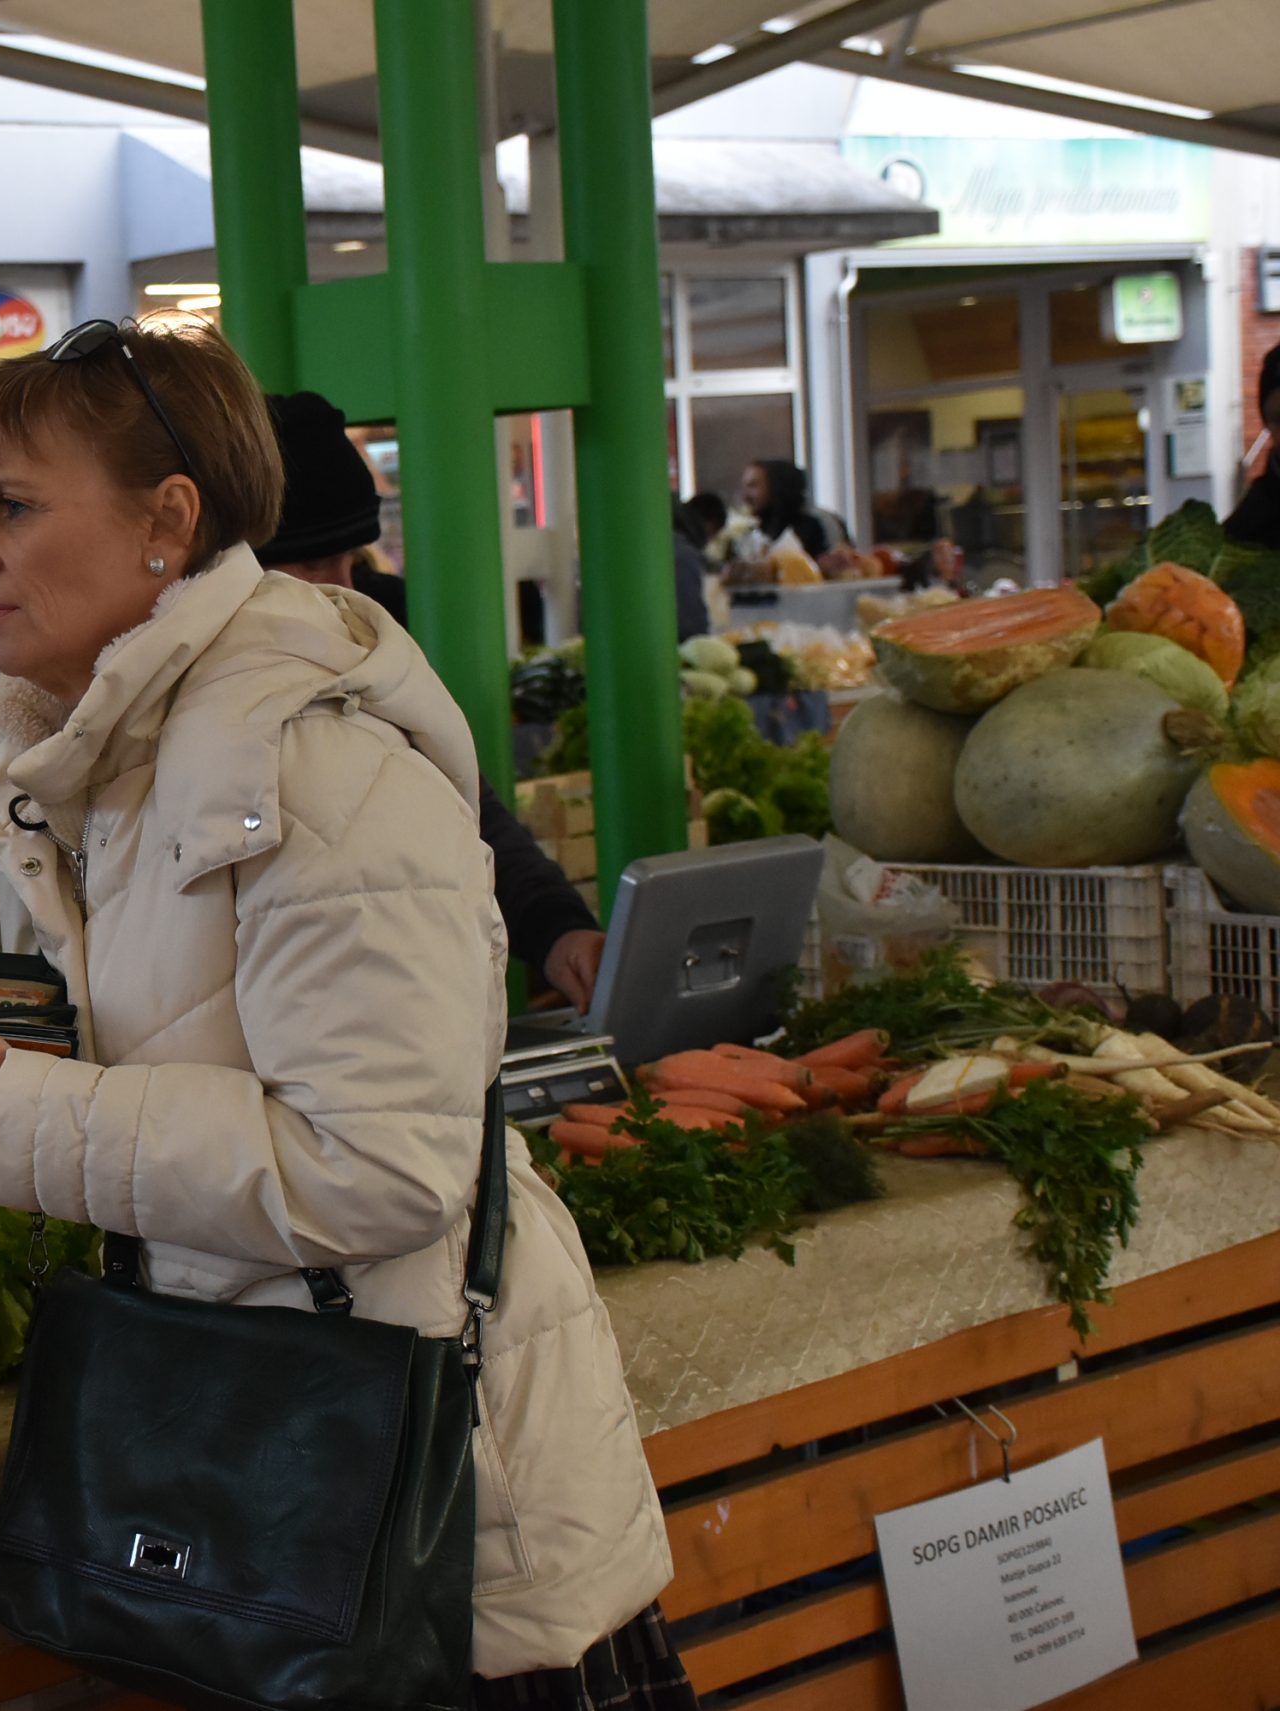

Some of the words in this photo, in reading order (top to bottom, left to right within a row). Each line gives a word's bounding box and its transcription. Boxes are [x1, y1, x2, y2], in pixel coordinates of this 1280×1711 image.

[912, 1535, 960, 1565] SOPG
[964, 1515, 1021, 1549] DAMIR
[1023, 1487, 1088, 1529] POSAVEC
